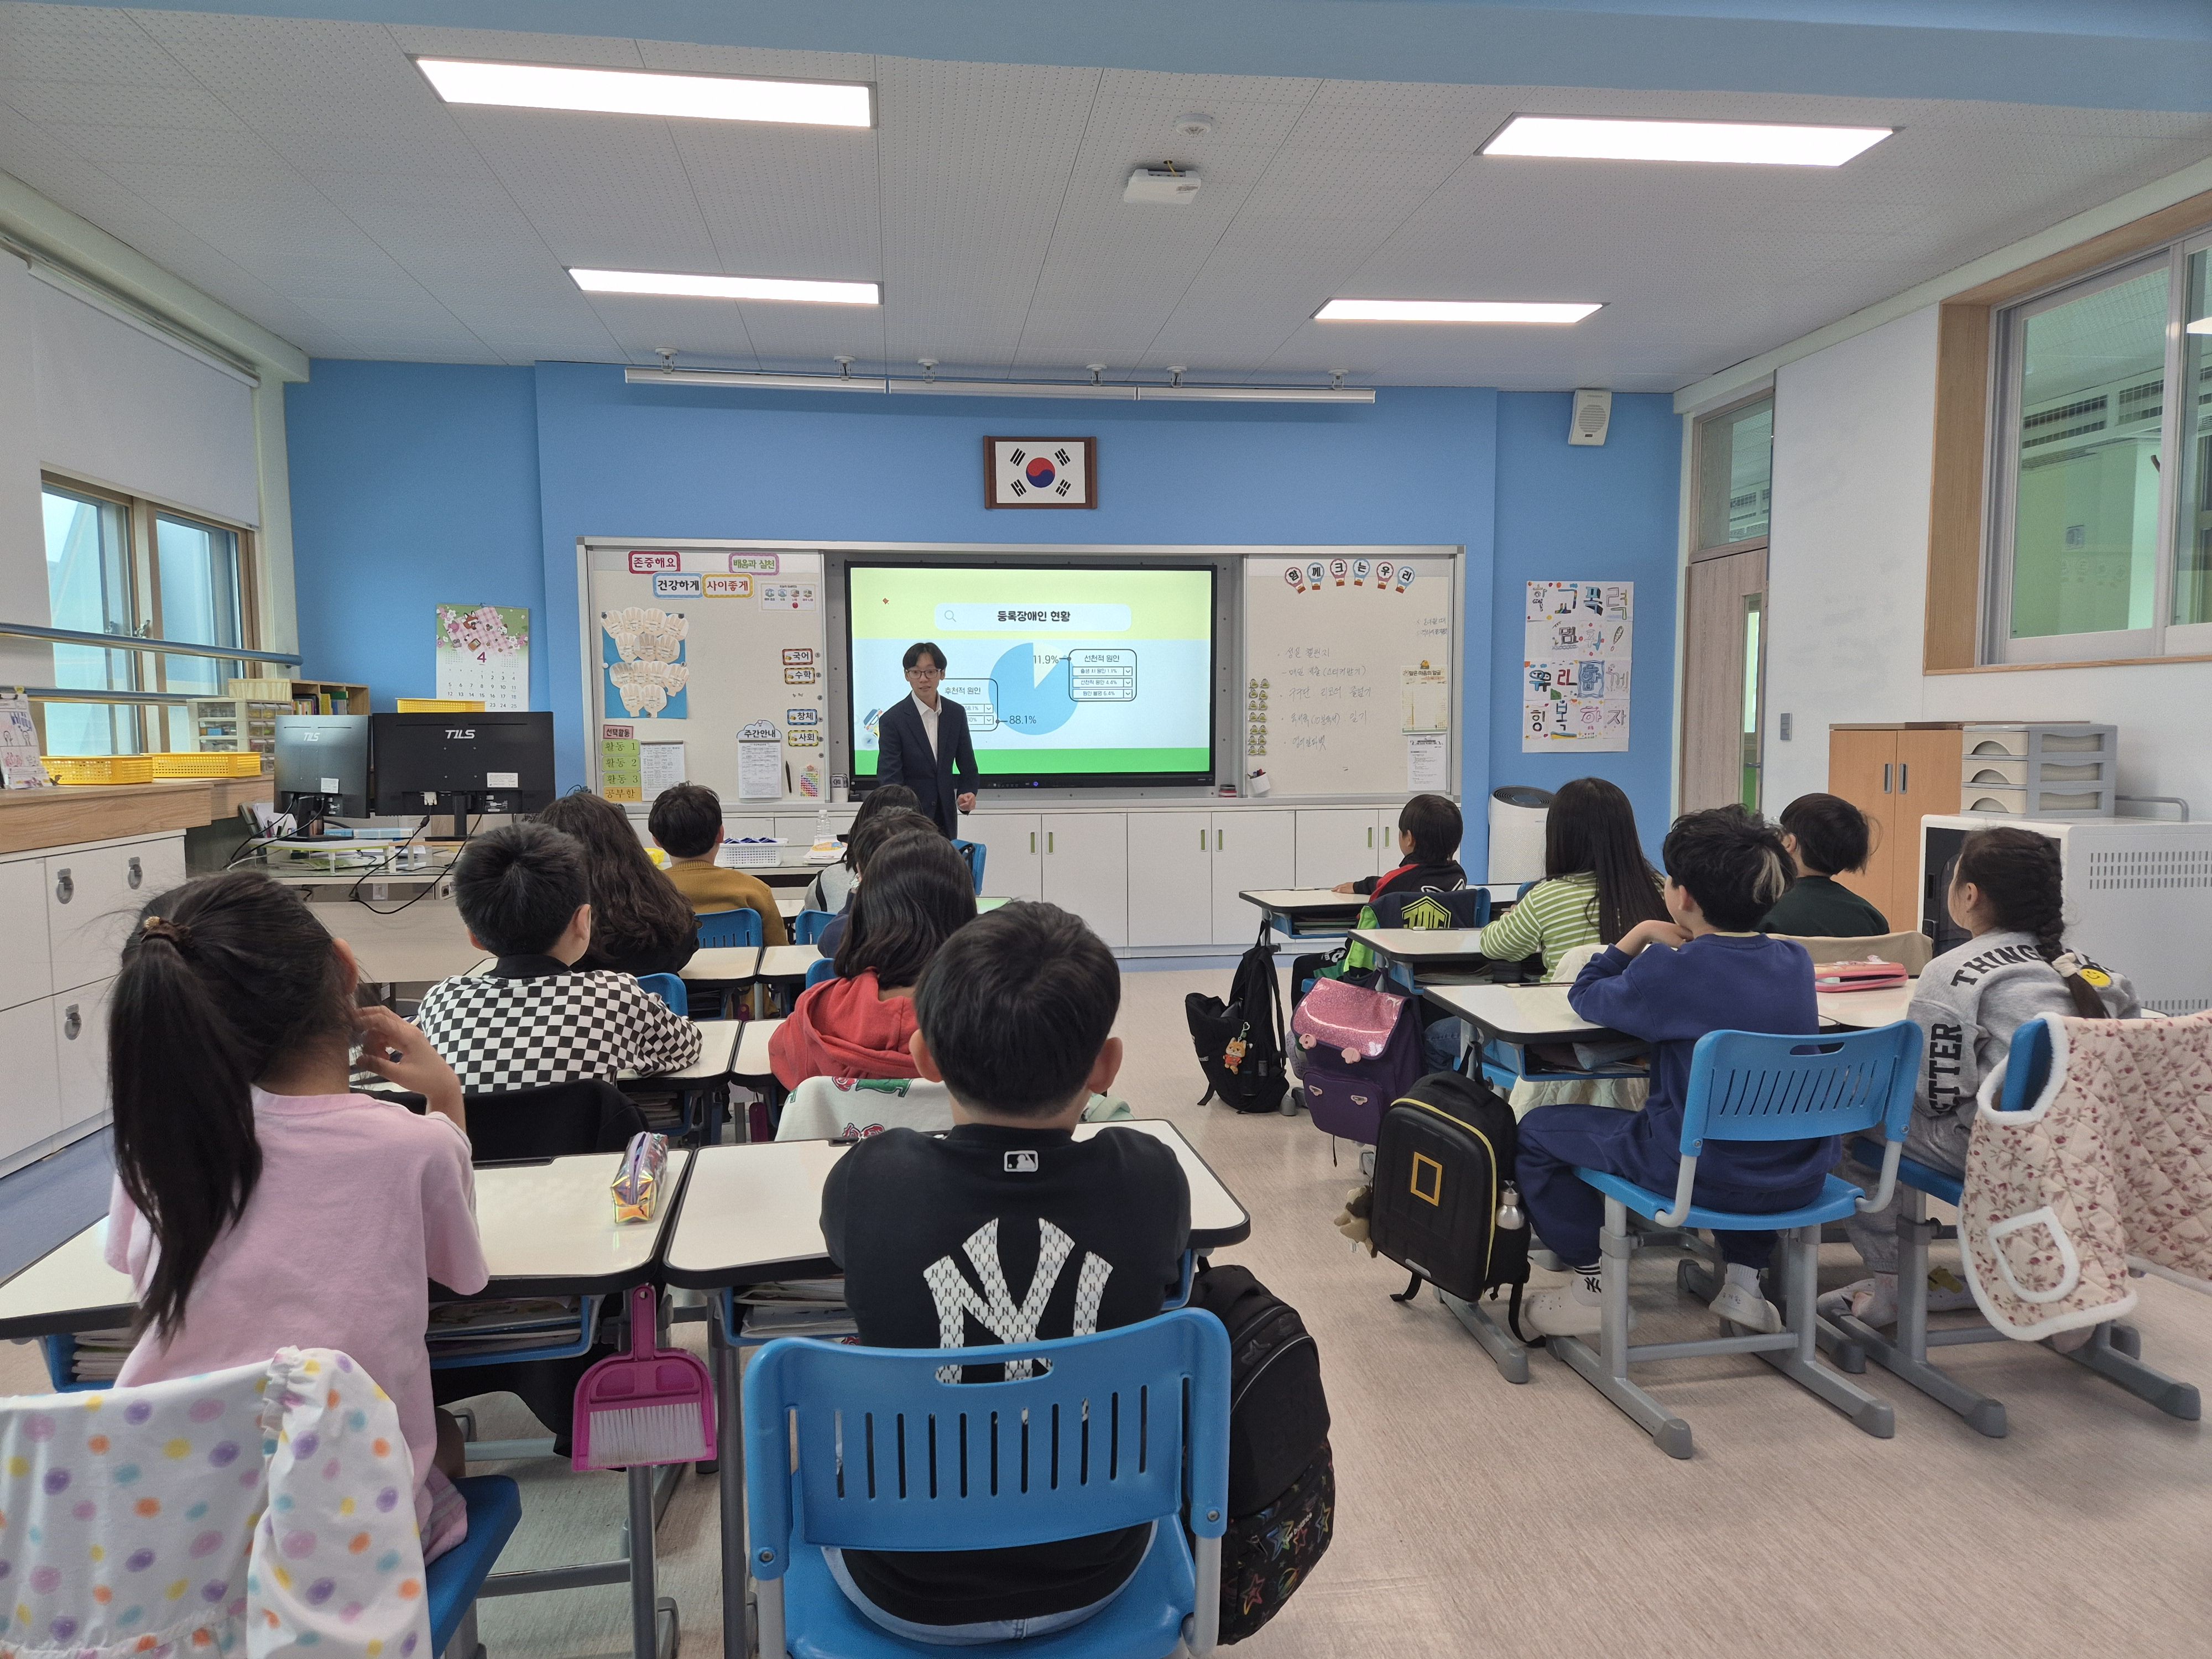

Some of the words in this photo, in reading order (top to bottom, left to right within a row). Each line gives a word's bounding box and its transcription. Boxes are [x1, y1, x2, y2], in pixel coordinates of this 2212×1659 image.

[634, 557, 676, 568] 존중해요
[733, 559, 757, 568] 배움과
[760, 559, 775, 569] 실천
[658, 580, 700, 591] 건강하게
[707, 581, 748, 591] 사이좋게
[998, 611, 1047, 622] 등록장애인
[1051, 611, 1071, 622] 현황
[477, 651, 487, 663] 4
[792, 652, 809, 660] 국어
[1034, 655, 1059, 664] 11.9%
[795, 671, 811, 679] 수학
[1009, 715, 1037, 724] 88.1%
[445, 729, 476, 739] TILS
[606, 728, 630, 737] 선택활동
[744, 729, 776, 738] 주간안내
[799, 733, 815, 742] 사회
[605, 742, 625, 752] 활동
[606, 758, 625, 768] 활동
[607, 774, 627, 784] 활동
[606, 788, 635, 799] 공부한
